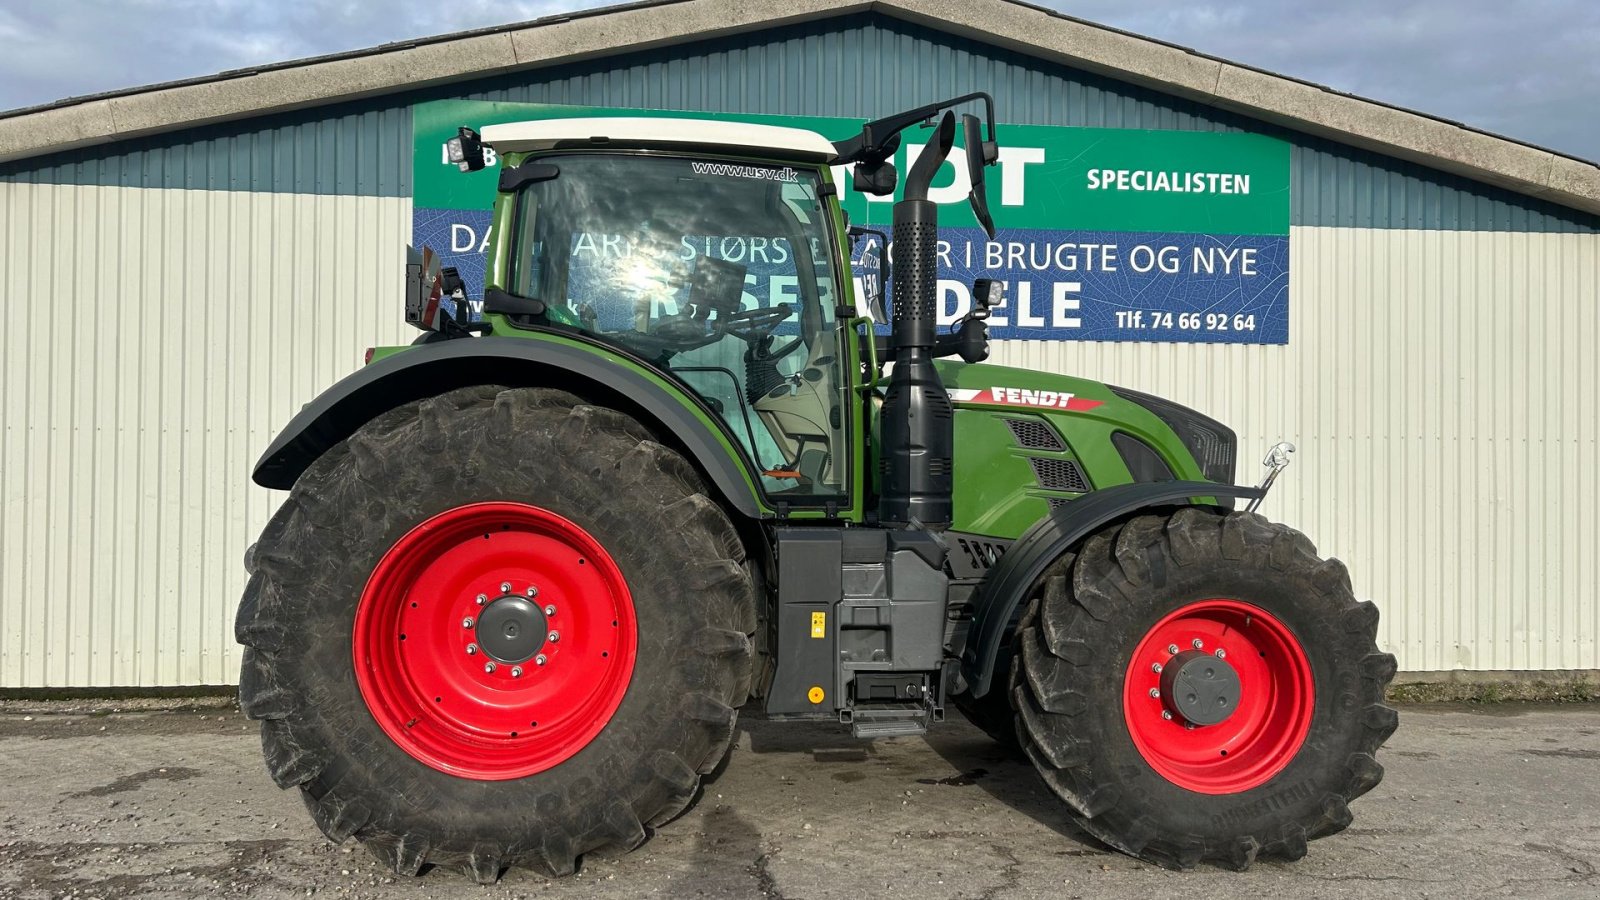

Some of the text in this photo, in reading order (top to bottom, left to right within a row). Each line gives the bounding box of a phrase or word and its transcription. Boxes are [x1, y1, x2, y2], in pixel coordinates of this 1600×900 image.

[691, 161, 799, 183] www.usv.dk
[1086, 169, 1250, 194] SPECIALISTEN
[985, 242, 1118, 272] BRUGTE
[1130, 245, 1180, 274] OG
[1193, 247, 1257, 275] NYE
[1115, 311, 1256, 331] Tlf. 74 66 92 64
[990, 386, 1075, 408] FENDT
